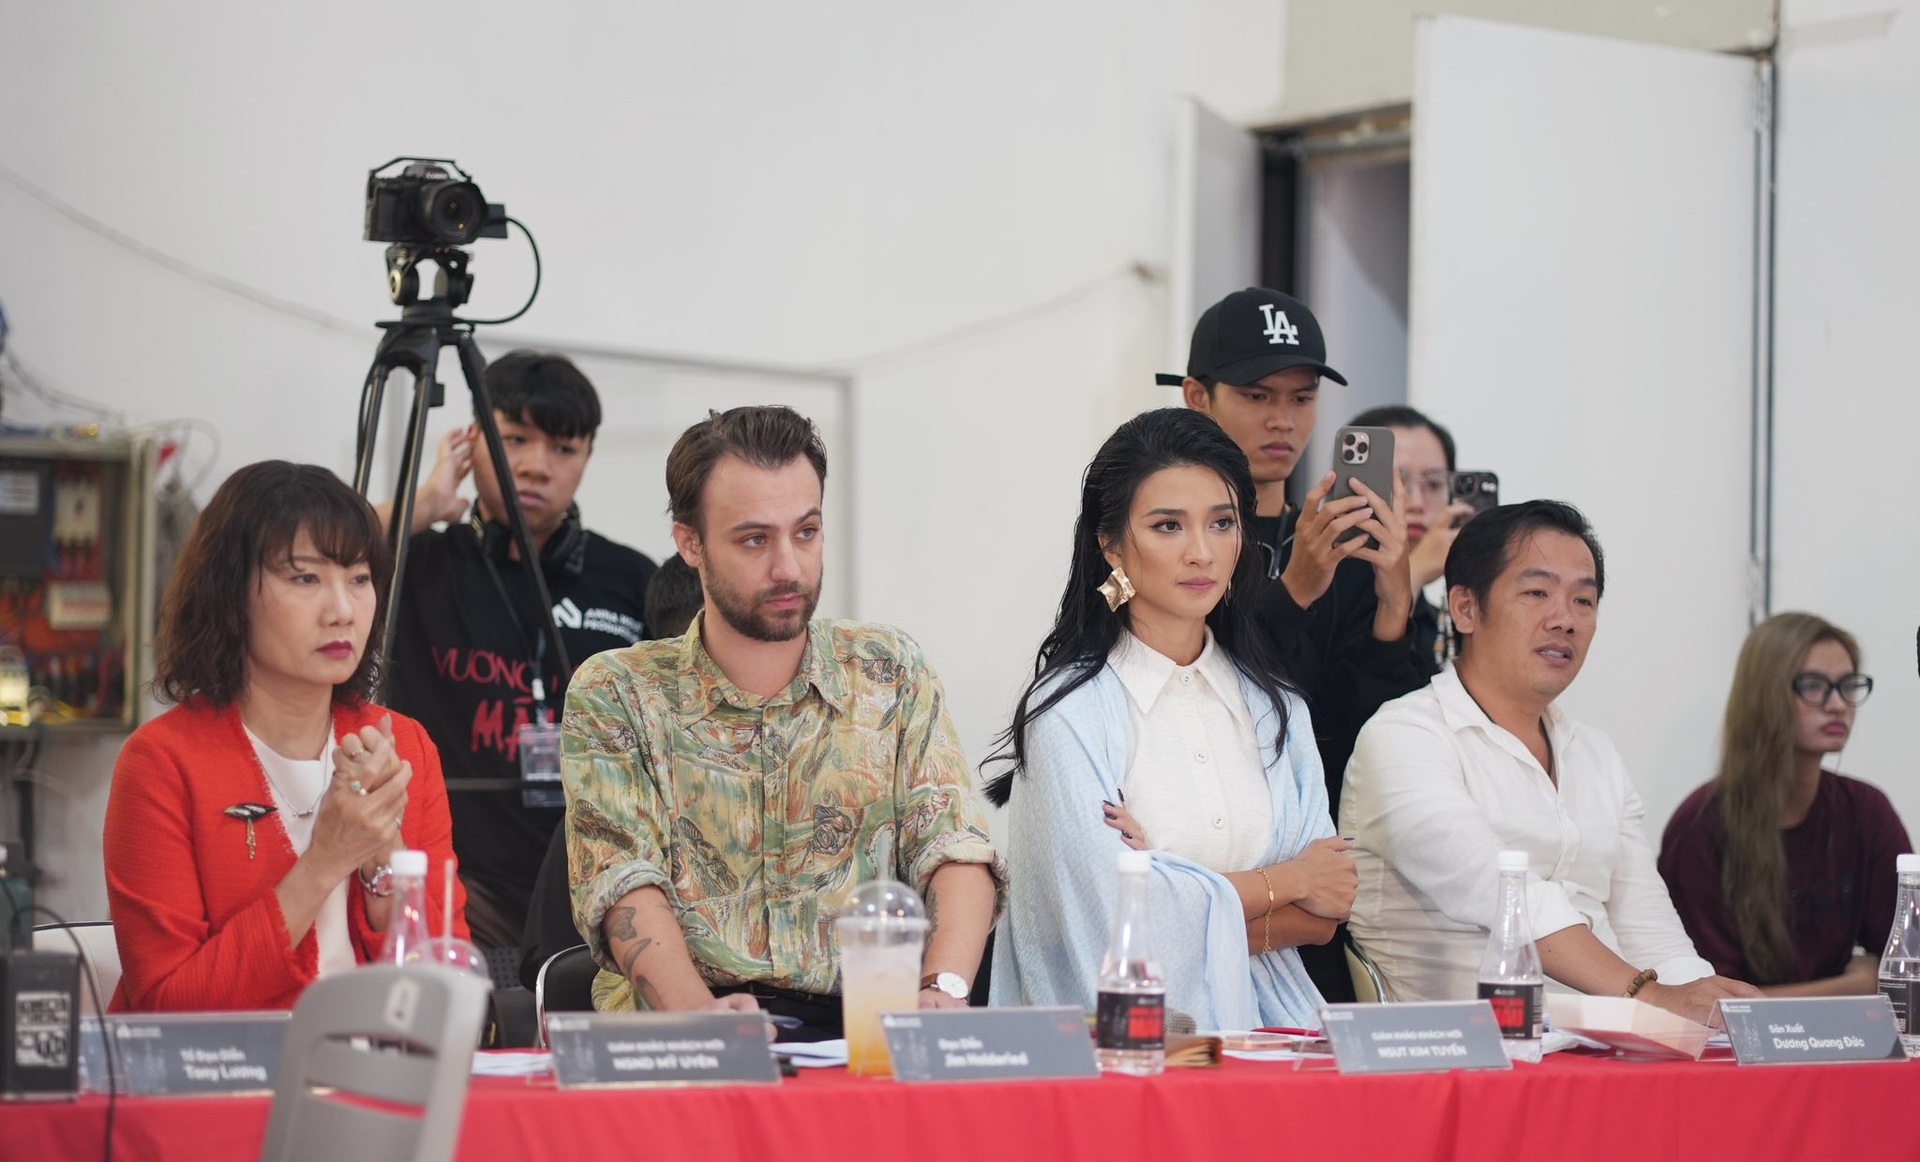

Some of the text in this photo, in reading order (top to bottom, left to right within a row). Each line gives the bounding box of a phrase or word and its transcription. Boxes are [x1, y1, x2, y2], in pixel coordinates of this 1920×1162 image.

[1258, 303, 1300, 345] LA
[1408, 1046, 1430, 1057] KIM
[1772, 1035, 1866, 1051] Dương Quang Đức
[183, 1063, 220, 1084] Tony
